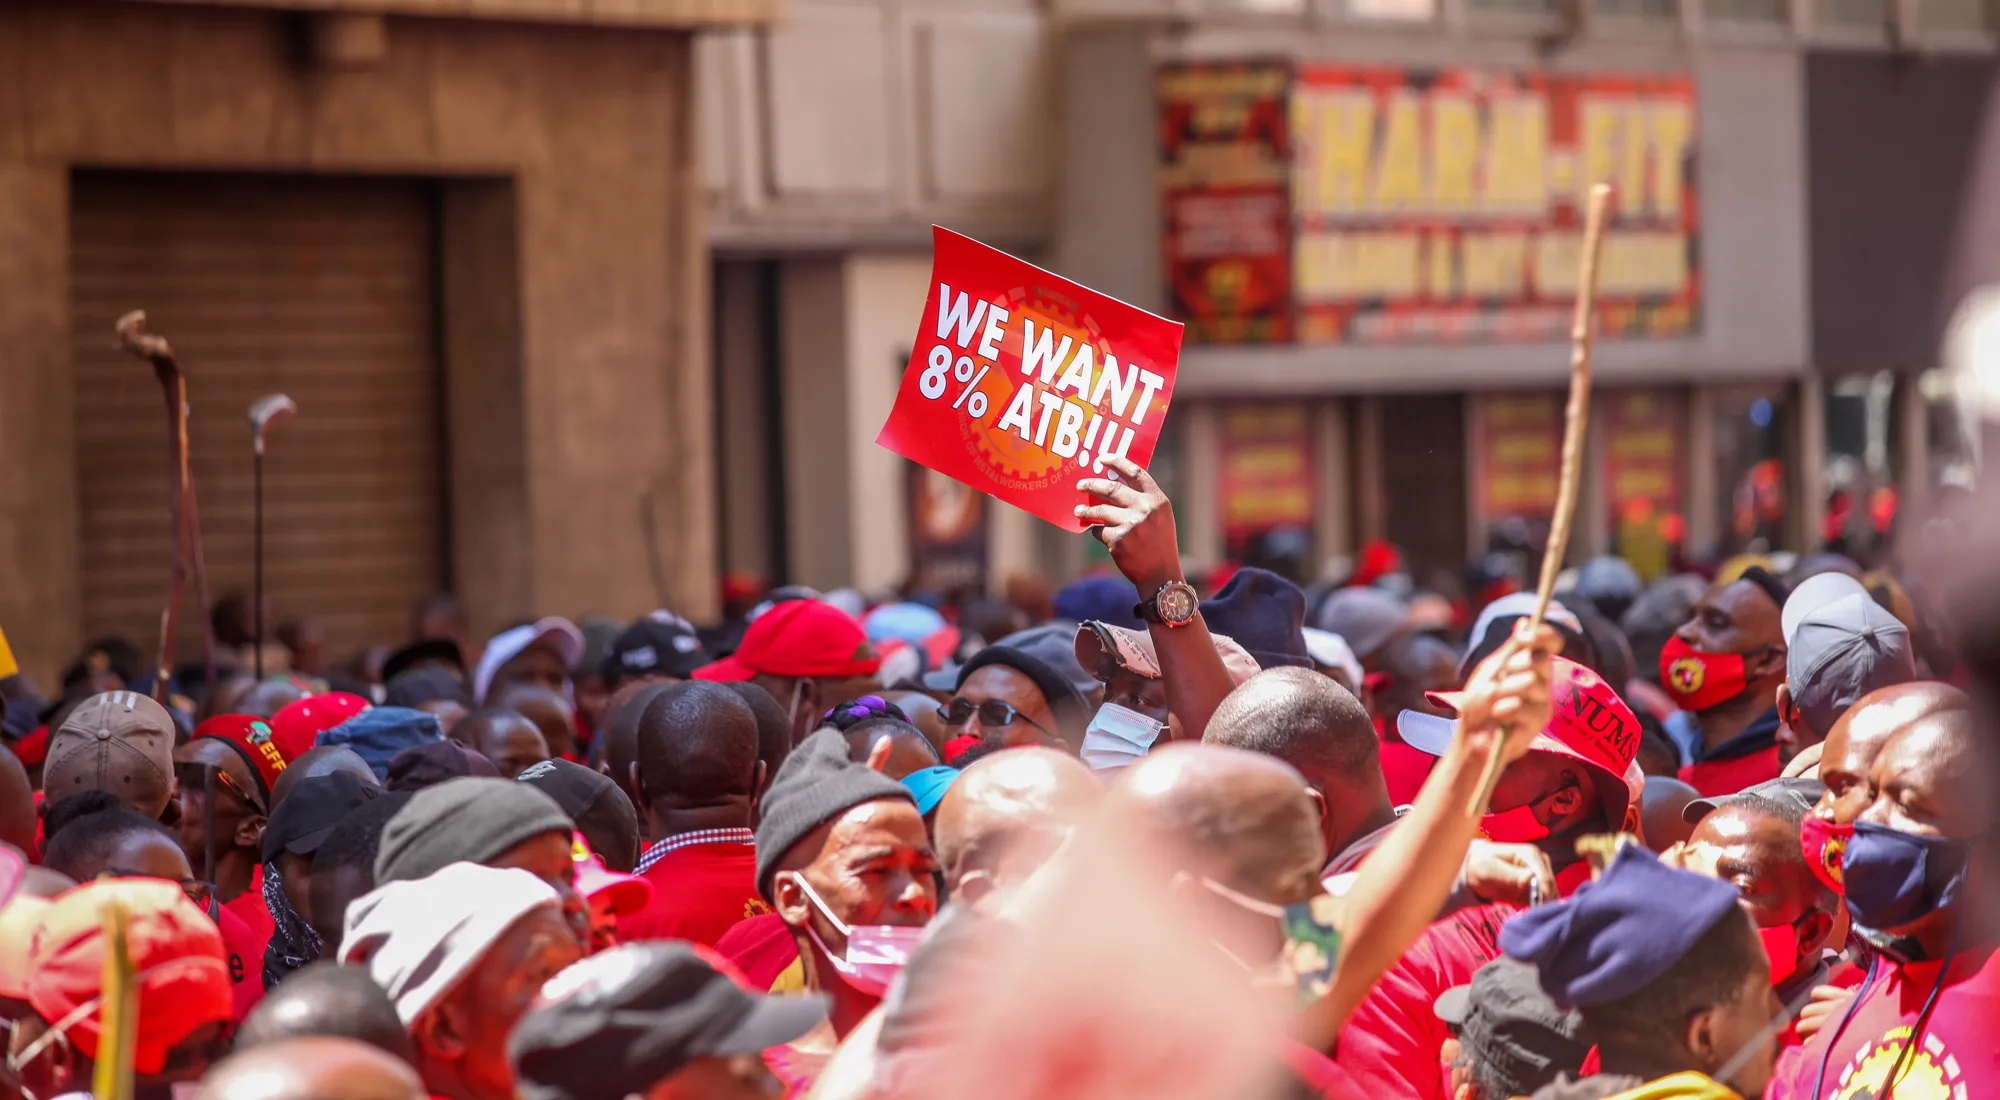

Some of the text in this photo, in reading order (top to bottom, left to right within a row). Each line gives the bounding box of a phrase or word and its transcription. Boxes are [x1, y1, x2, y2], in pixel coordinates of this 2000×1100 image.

[918, 343, 989, 419] 8%
[935, 282, 1165, 425] WE WANT
[973, 455, 1049, 491] METALWORKERS
[1050, 471, 1063, 485] OF
[259, 741, 287, 771] EFF
